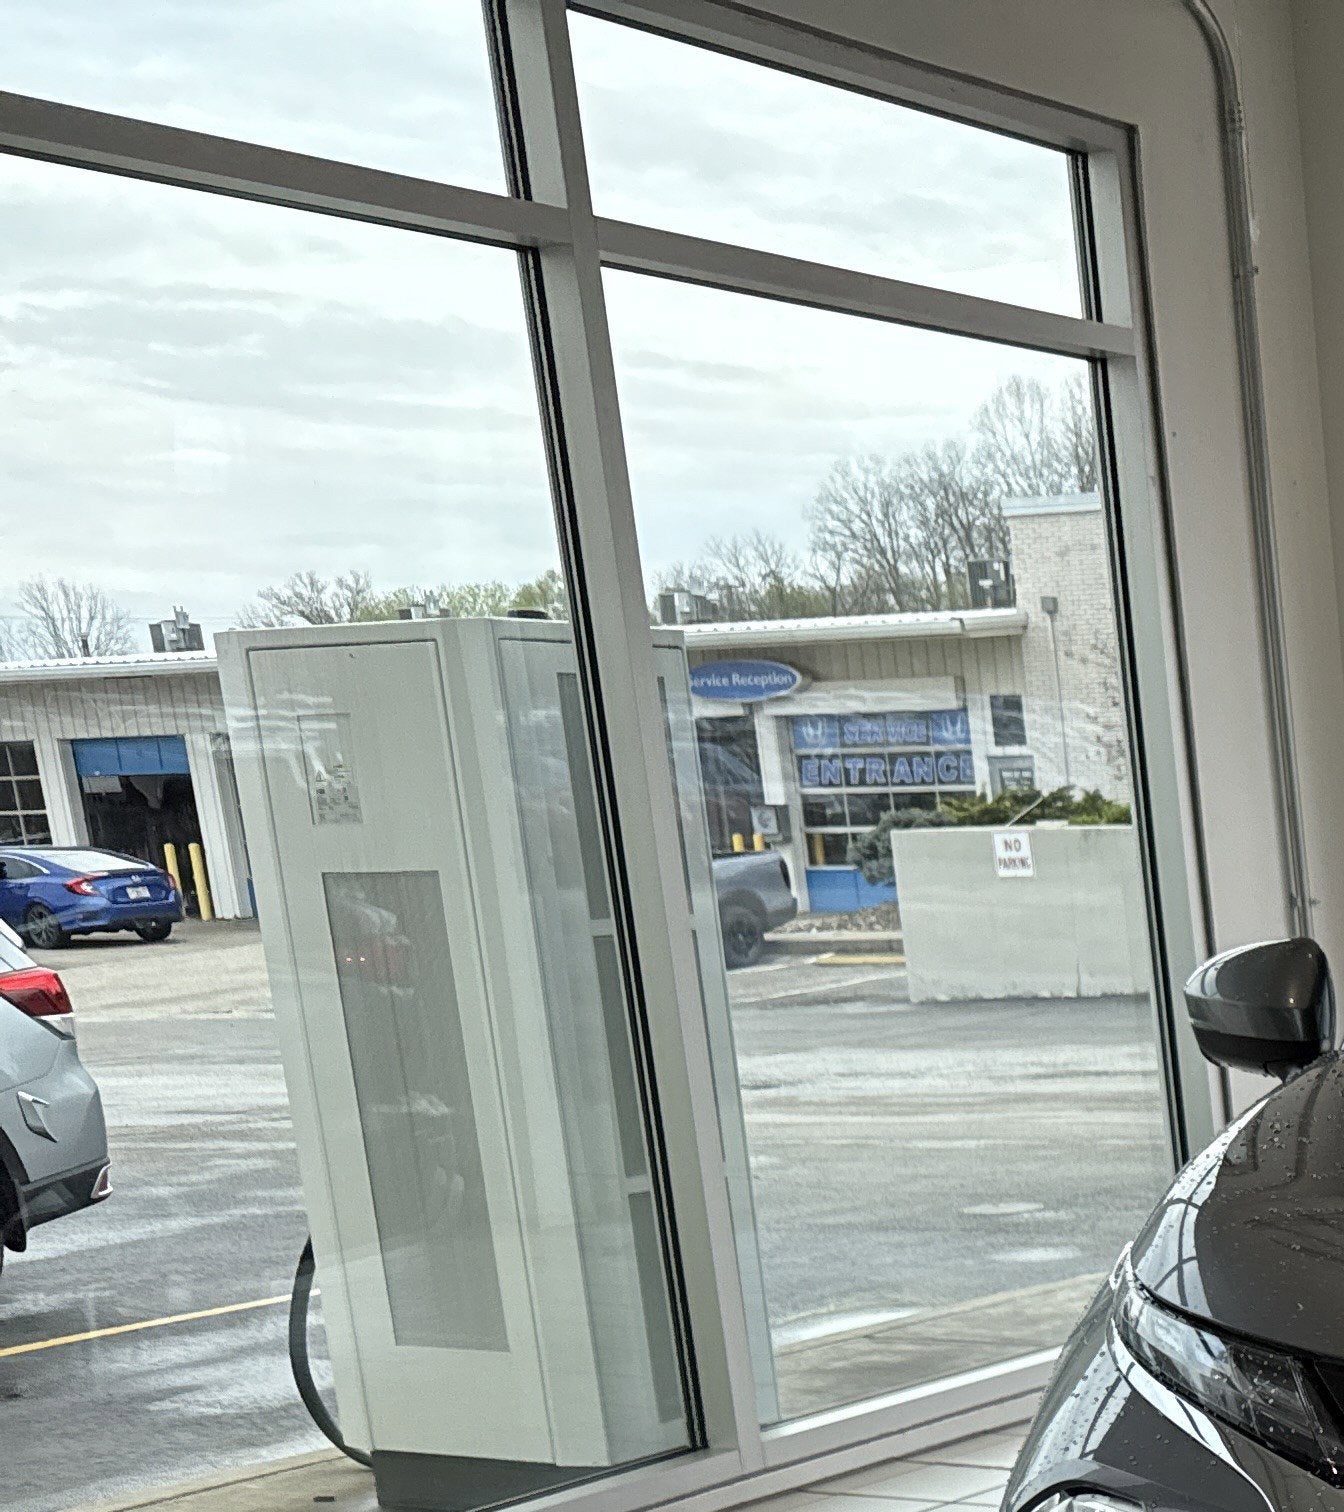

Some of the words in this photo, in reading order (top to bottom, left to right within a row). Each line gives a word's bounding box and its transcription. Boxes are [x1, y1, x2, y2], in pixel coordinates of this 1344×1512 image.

[731, 671, 794, 689] Reception
[1003, 838, 1022, 853] NO
[997, 857, 1031, 871] PARKING
